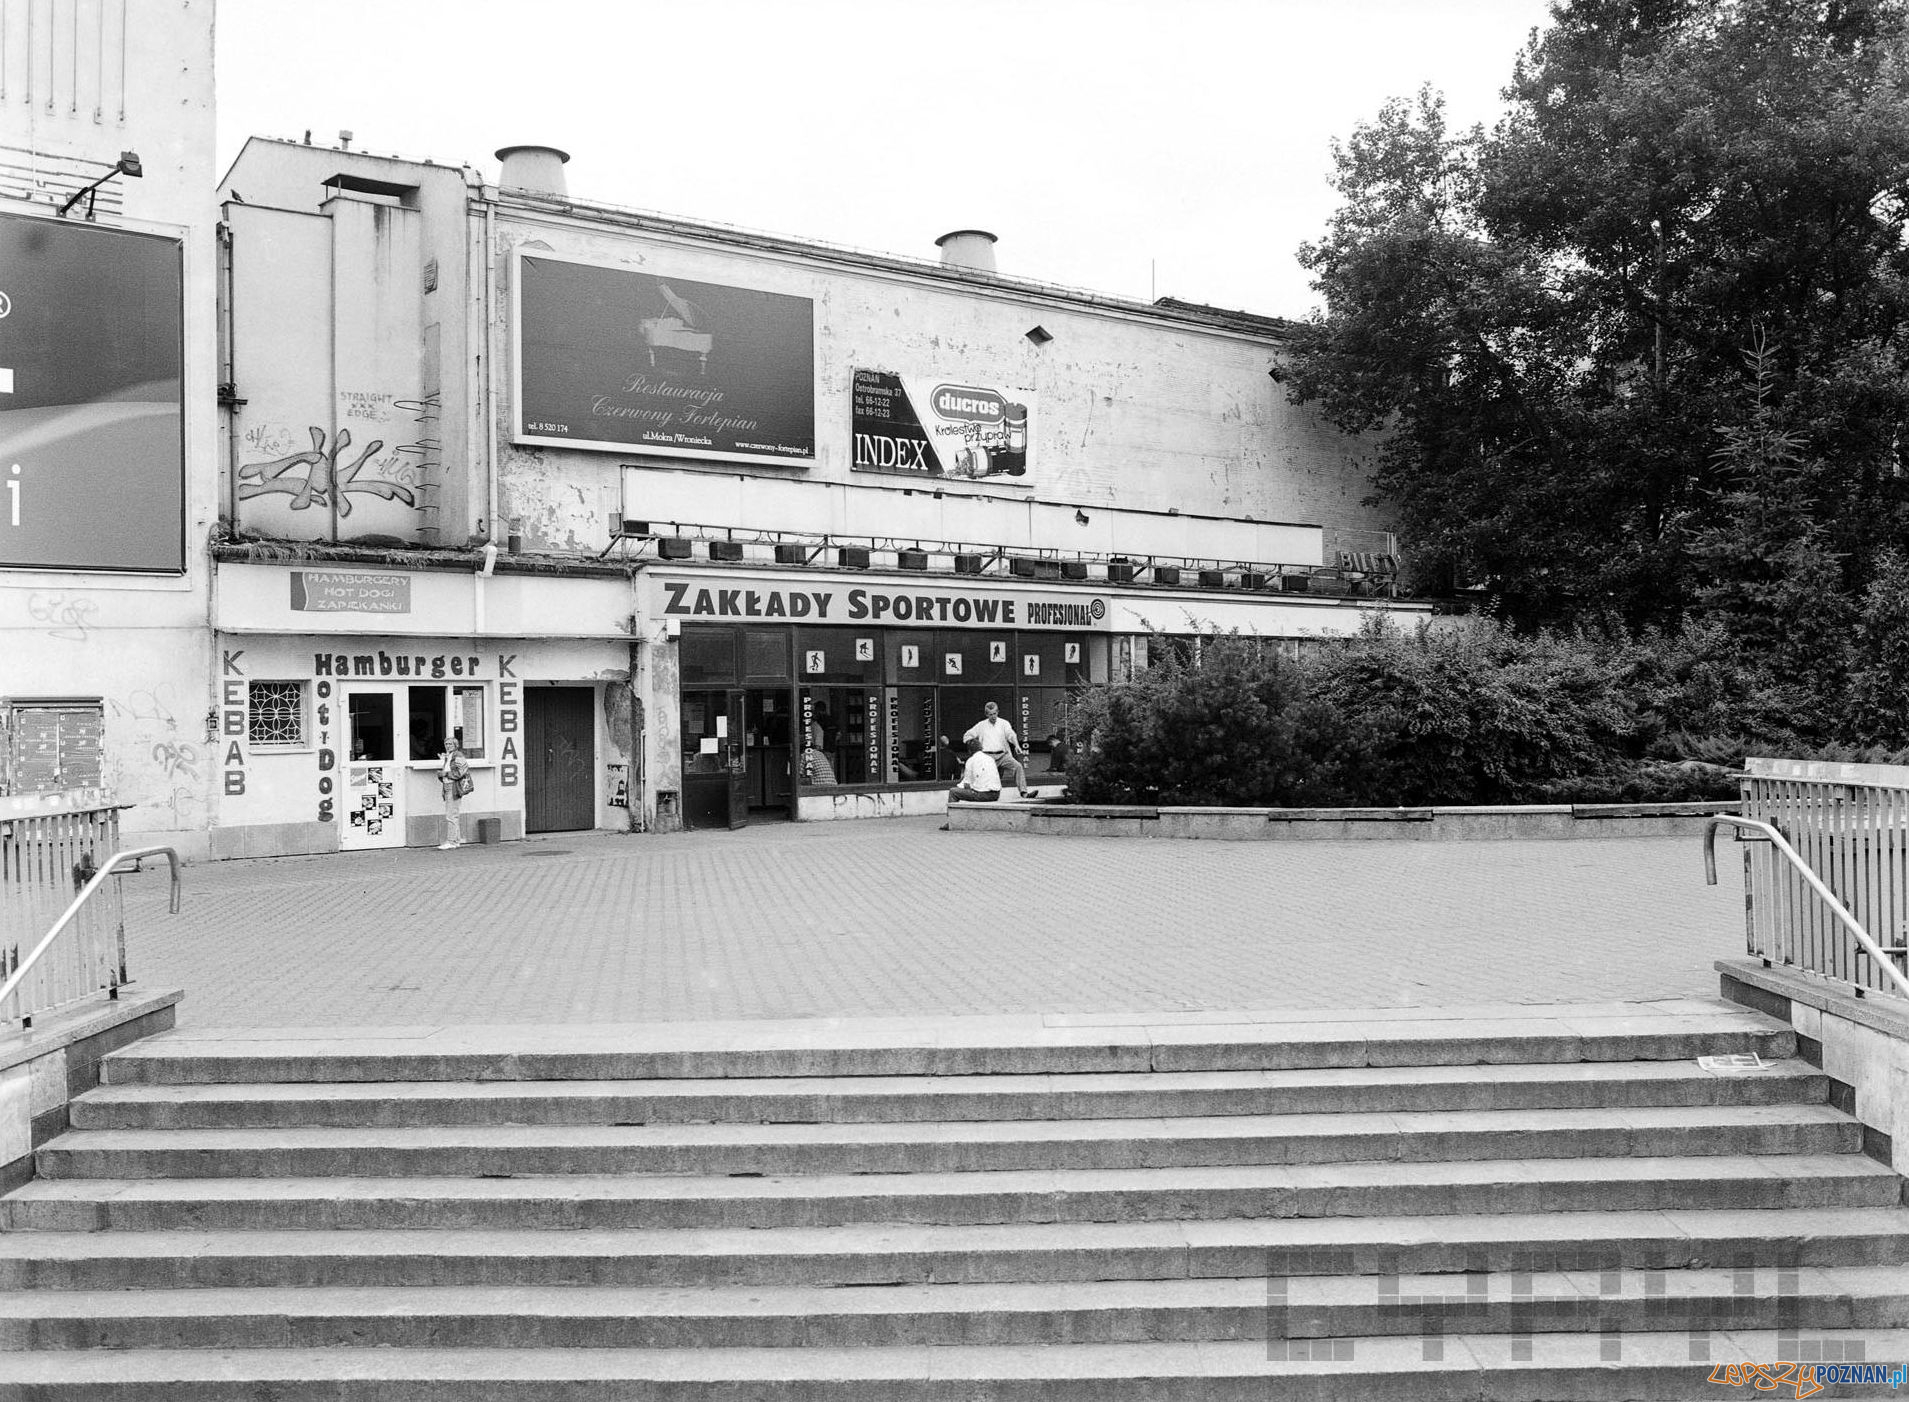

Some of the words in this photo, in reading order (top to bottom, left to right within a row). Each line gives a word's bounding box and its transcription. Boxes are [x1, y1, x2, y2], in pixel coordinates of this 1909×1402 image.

[623, 373, 724, 406] Restauracja
[894, 388, 902, 397] 37
[939, 392, 1000, 415] ducros
[591, 395, 672, 427] Czerwony
[679, 403, 758, 433] Fortepian
[855, 434, 929, 471] INDEX
[308, 573, 409, 586] HAMBURGERY
[324, 586, 355, 597] HOT
[1027, 602, 1092, 626] PROFESJONAŁ
[315, 650, 480, 679] Hamburger
[223, 650, 246, 796] KEBAB
[498, 654, 519, 787] KEBAB
